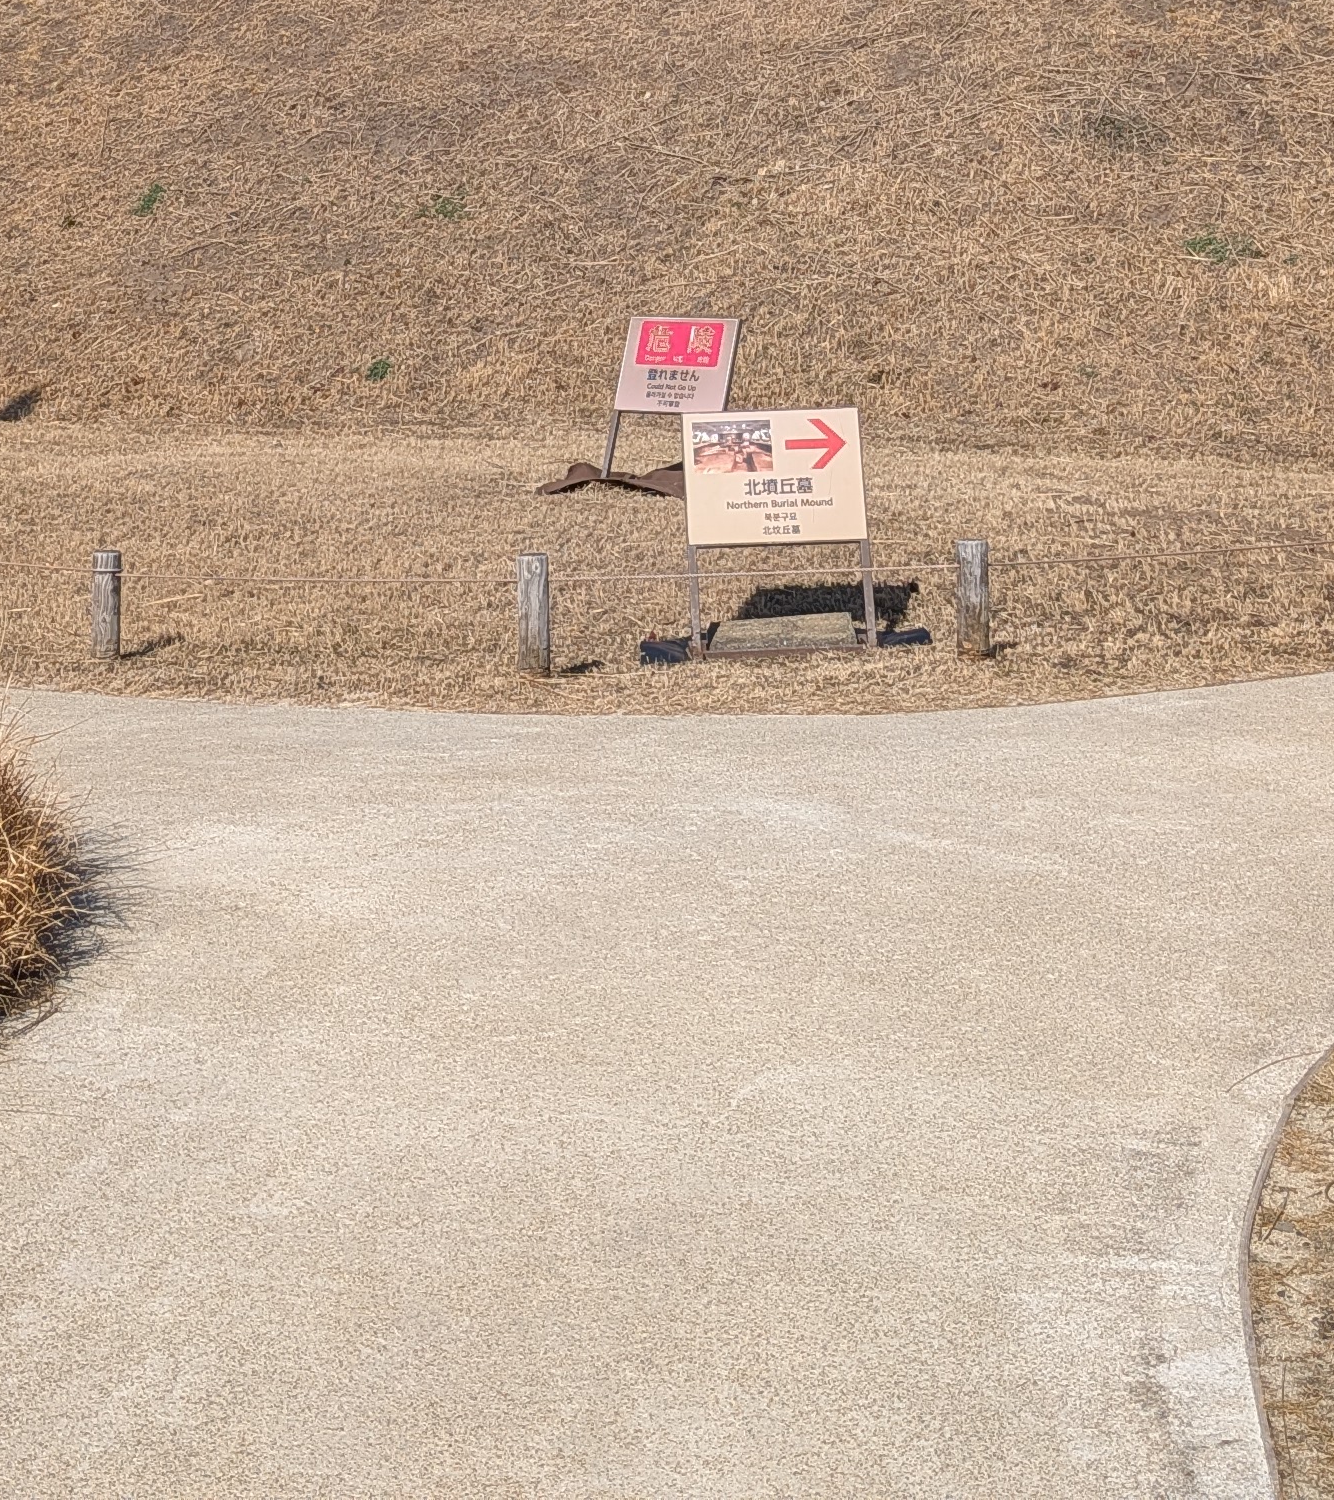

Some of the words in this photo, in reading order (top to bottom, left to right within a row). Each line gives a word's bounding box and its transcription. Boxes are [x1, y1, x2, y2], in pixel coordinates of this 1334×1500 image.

[647, 368, 700, 381] 登れません
[687, 384, 696, 392] Up
[744, 477, 813, 496] 北墳丘墓
[726, 499, 769, 510] Northern
[771, 498, 798, 508] Burial
[800, 497, 834, 507] Mound
